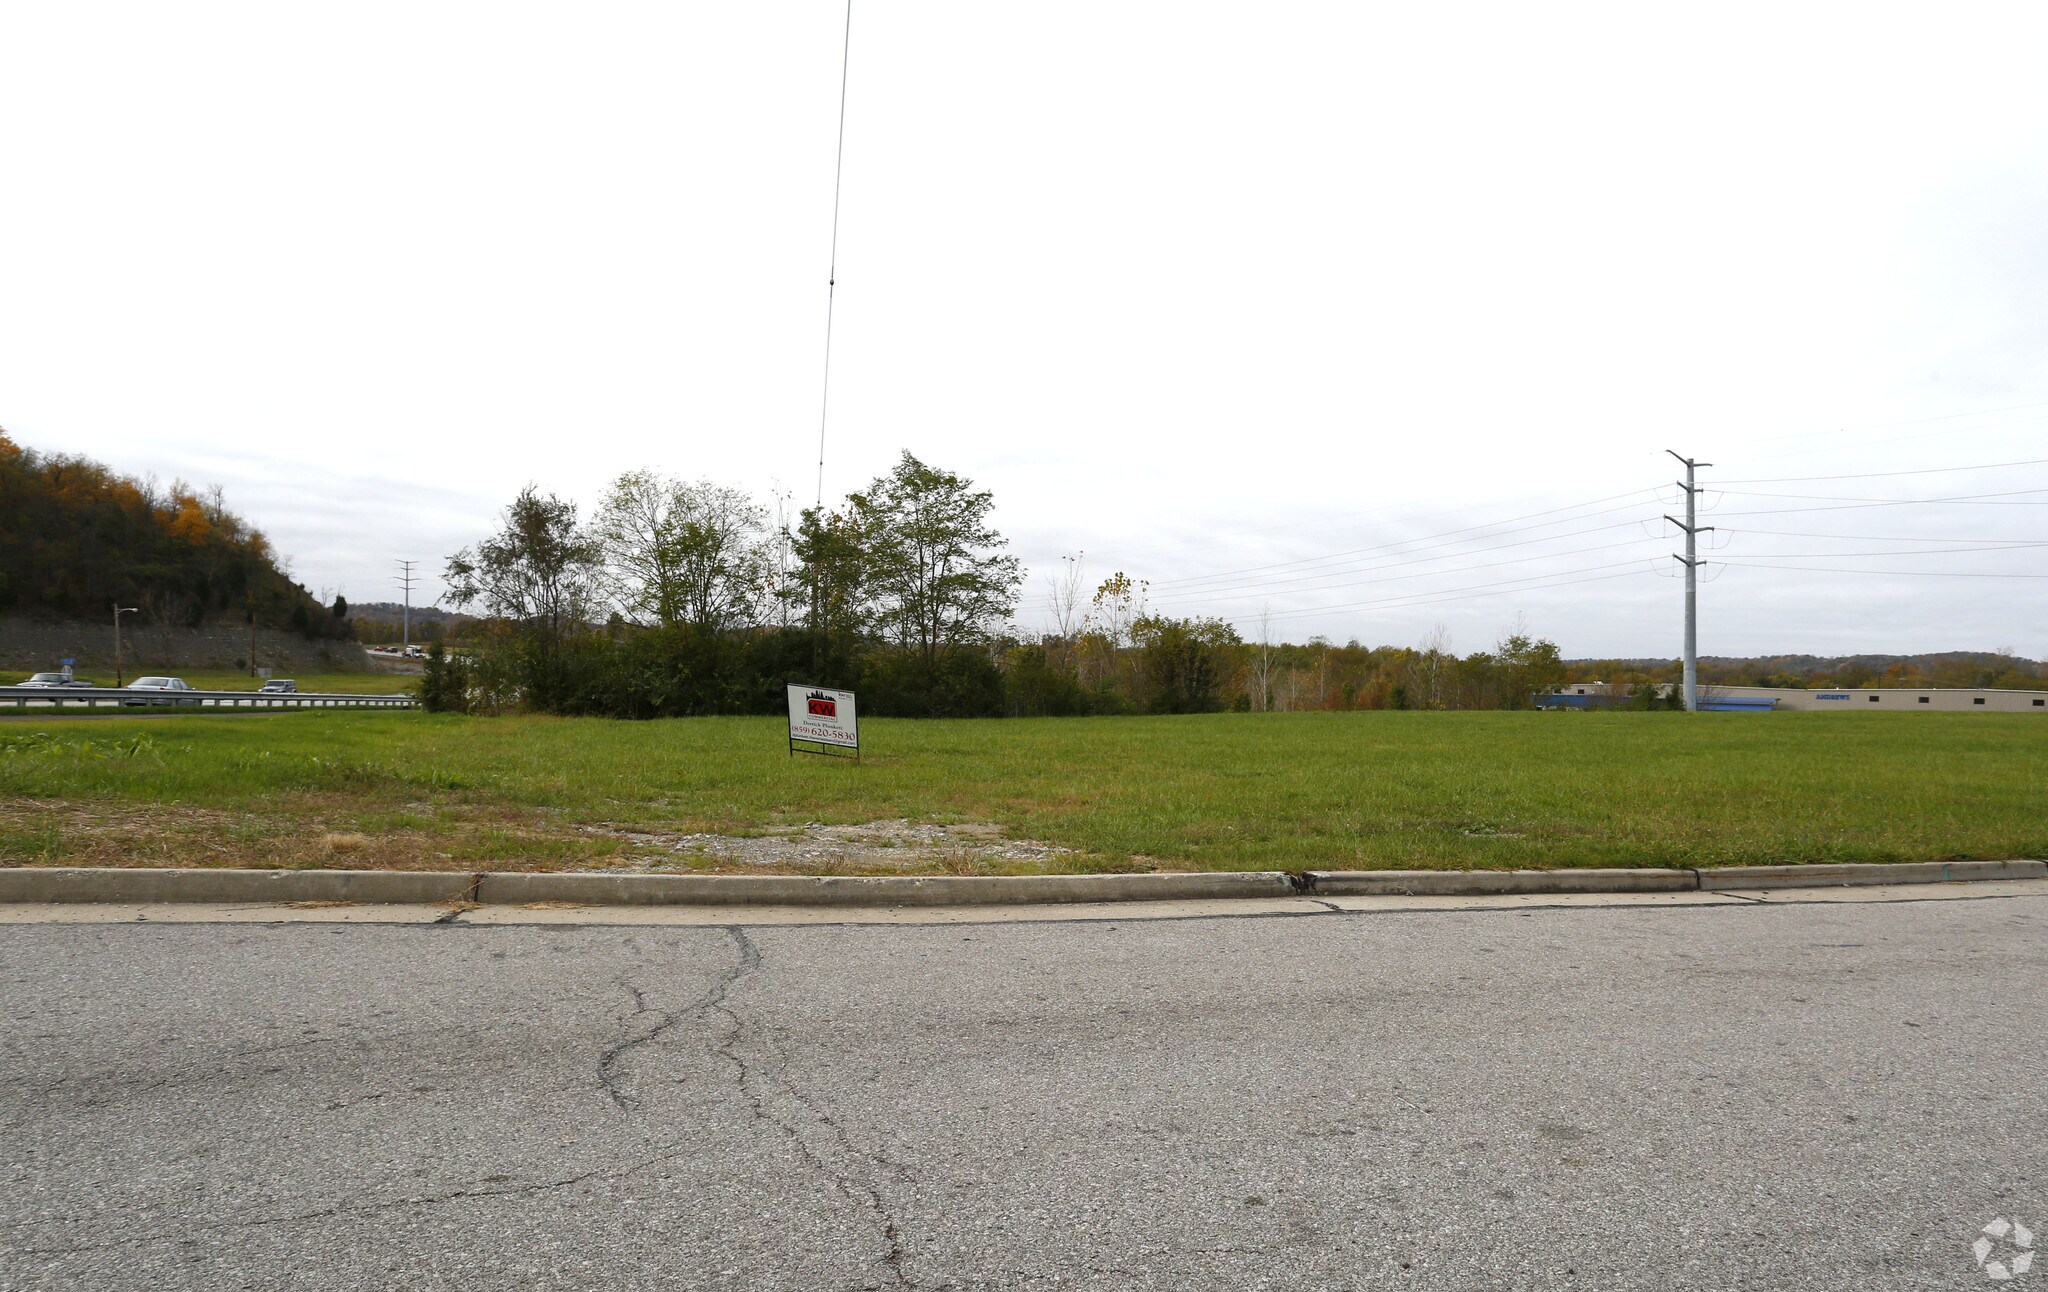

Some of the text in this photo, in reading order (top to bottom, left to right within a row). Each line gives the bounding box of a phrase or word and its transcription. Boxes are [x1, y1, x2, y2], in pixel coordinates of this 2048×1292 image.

[809, 703, 835, 716] KW
[792, 725, 810, 734] (859)
[811, 727, 856, 741] 620-5830
